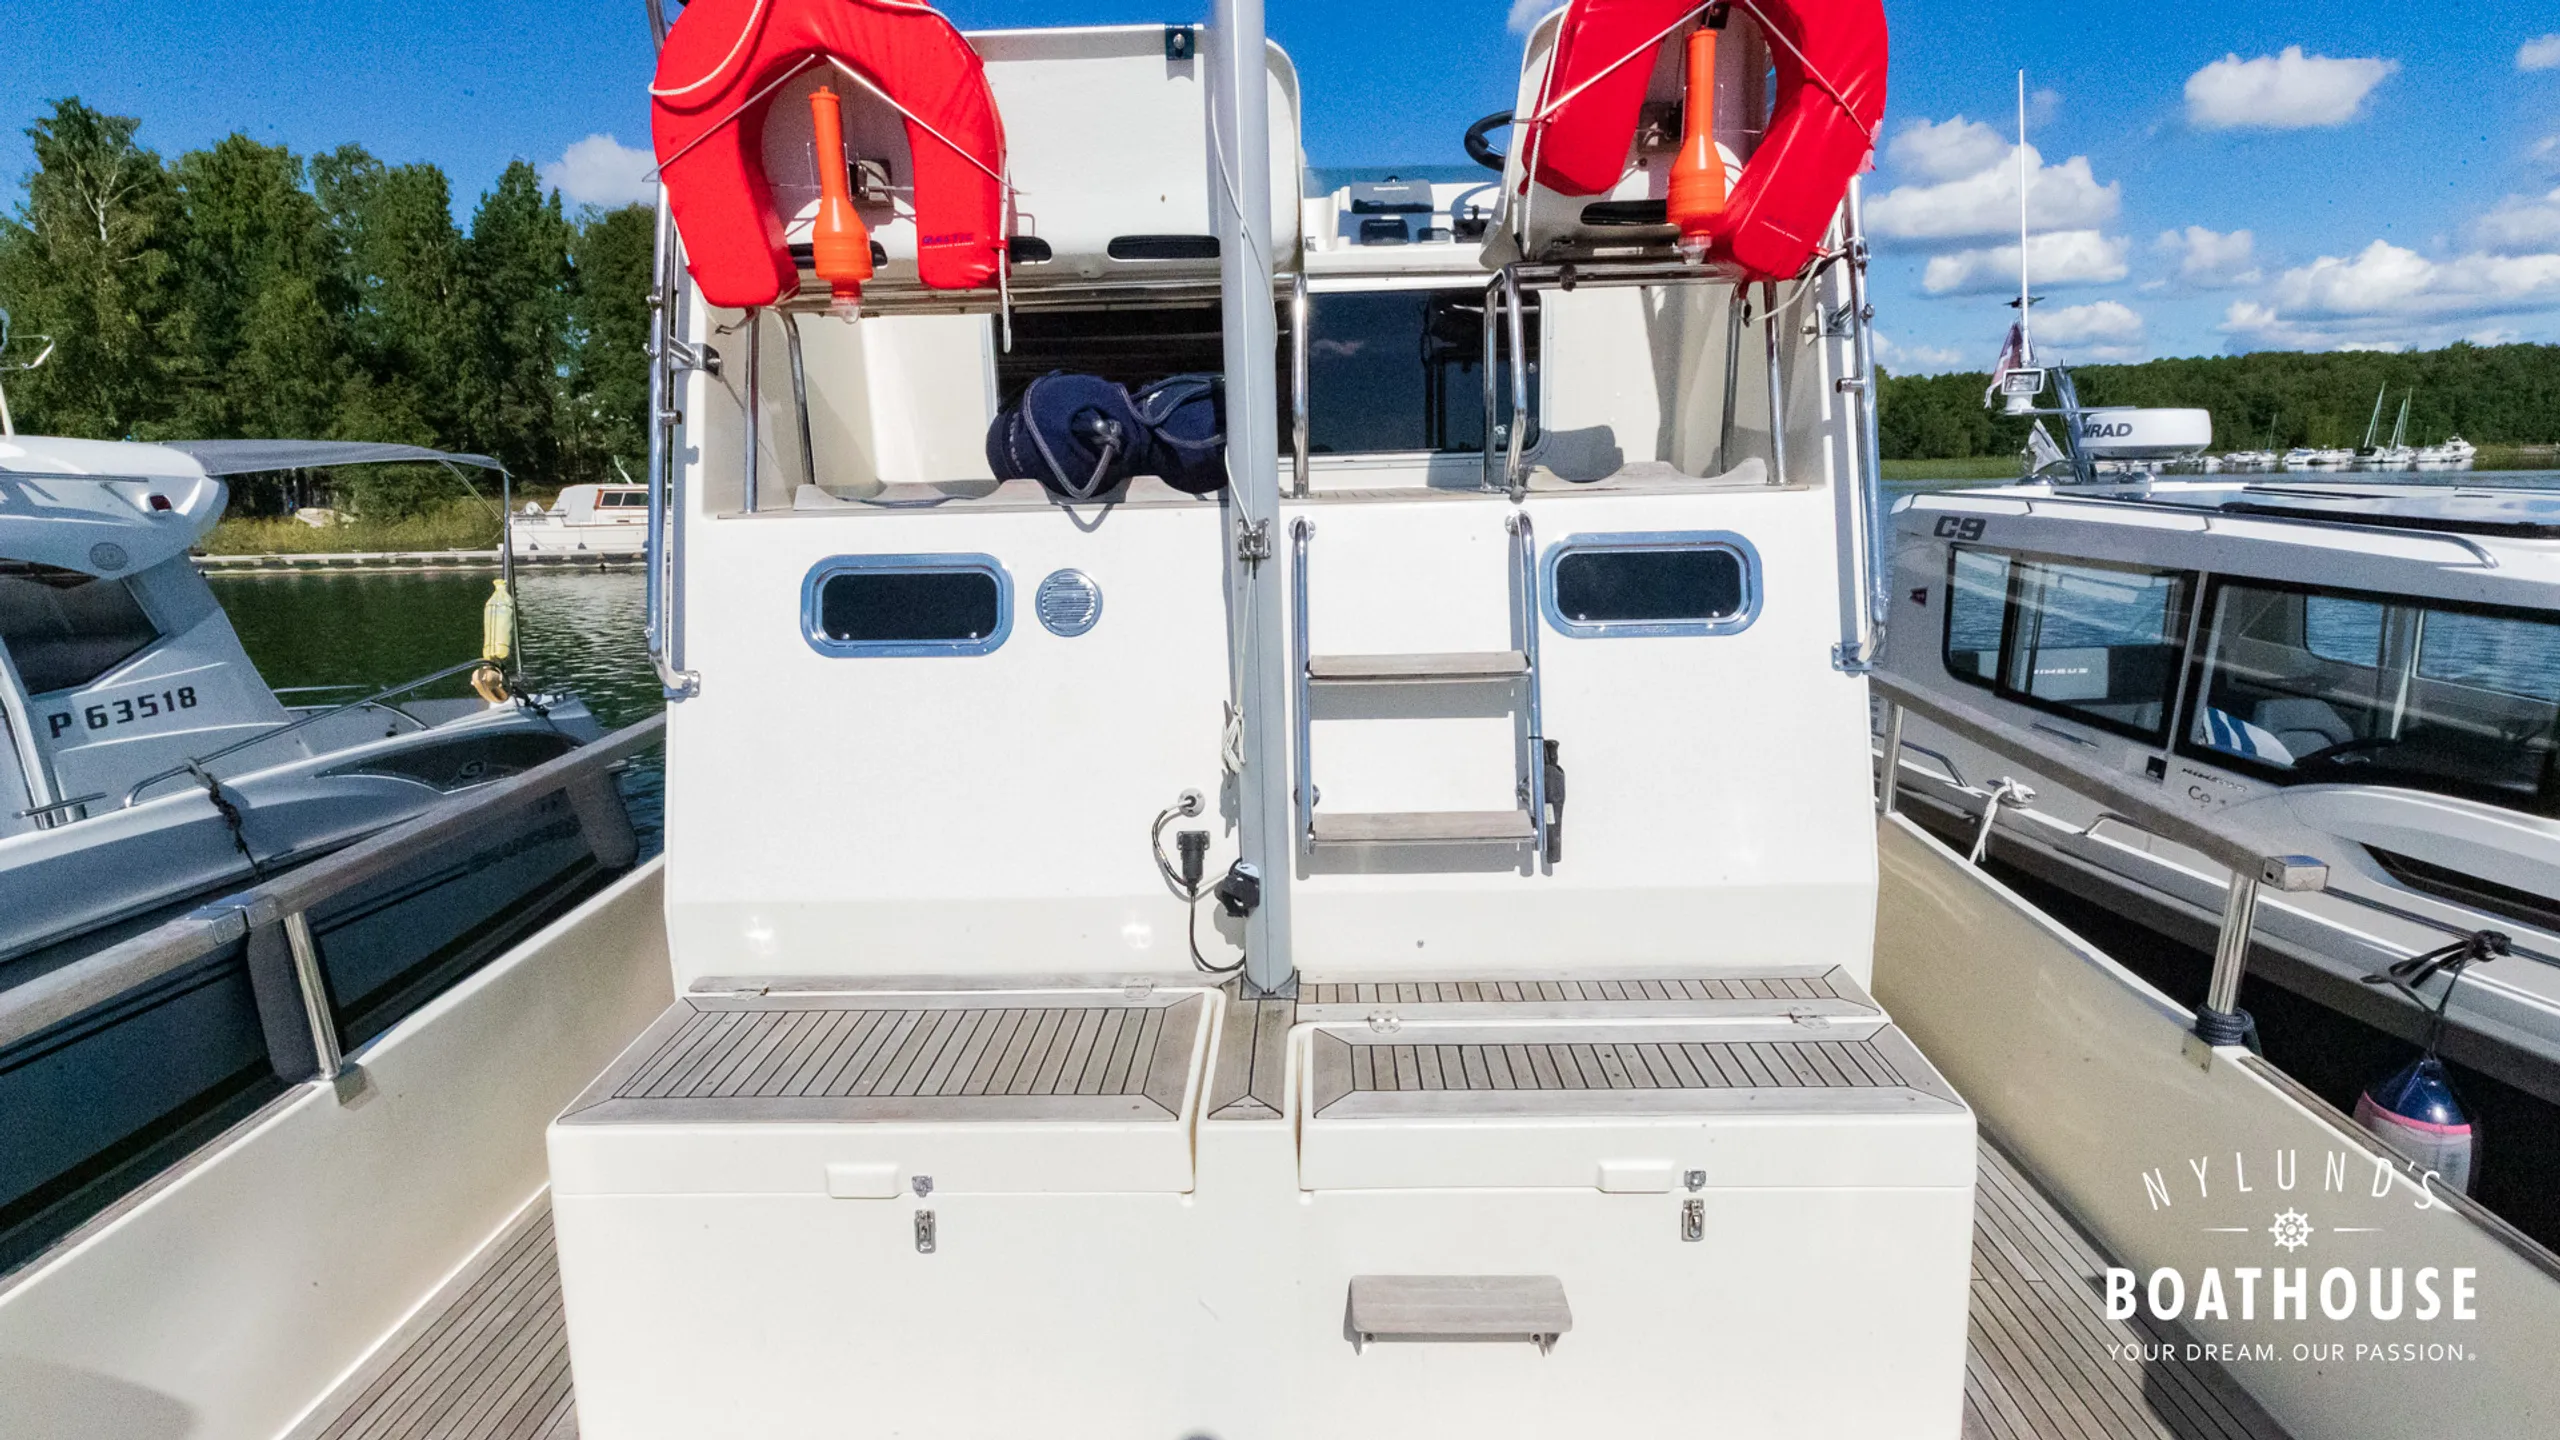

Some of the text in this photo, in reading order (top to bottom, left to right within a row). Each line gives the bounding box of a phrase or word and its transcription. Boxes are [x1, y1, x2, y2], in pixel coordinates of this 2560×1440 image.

[1934, 515, 1987, 541] C9
[47, 686, 198, 739] P 63518
